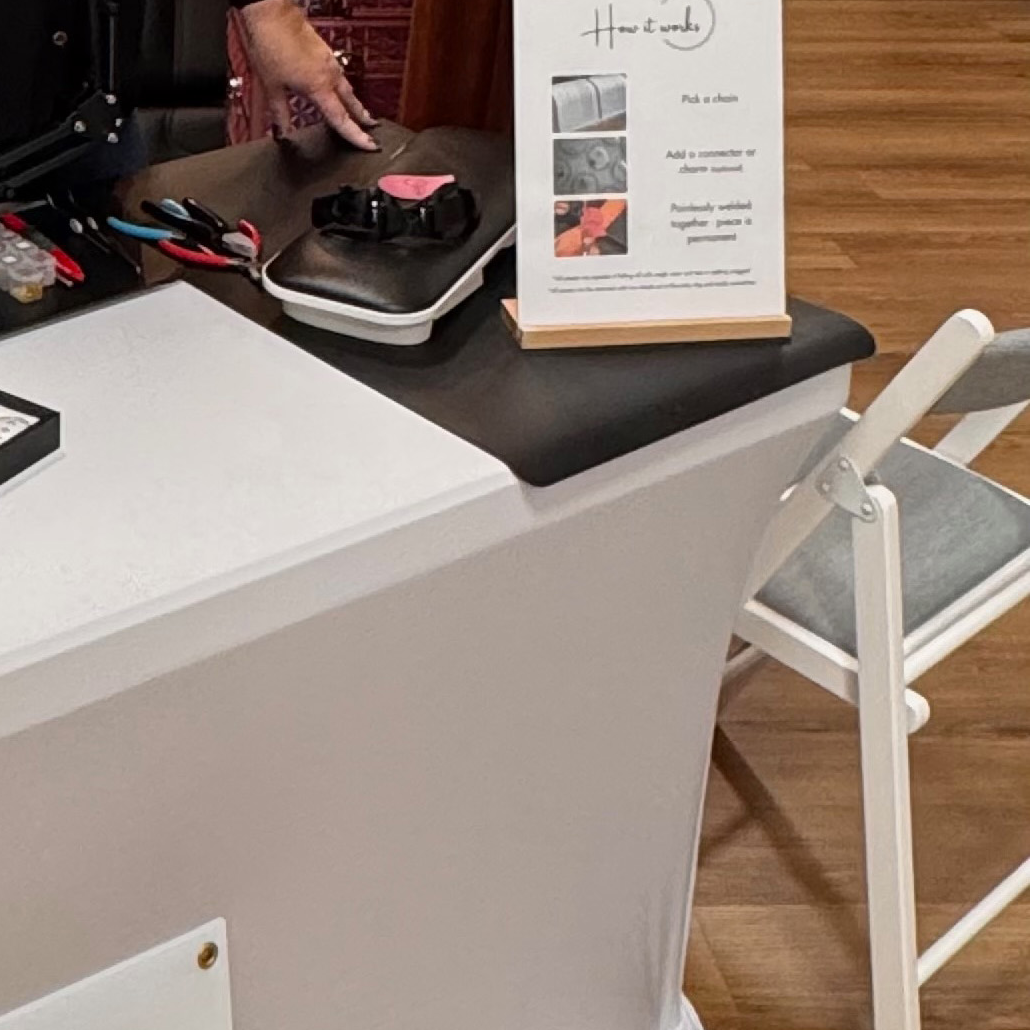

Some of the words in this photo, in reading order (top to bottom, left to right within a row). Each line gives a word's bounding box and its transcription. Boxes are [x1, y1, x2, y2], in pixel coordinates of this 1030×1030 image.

[580, 3, 640, 50] How
[643, 16, 658, 33] it
[660, 5, 701, 33] works
[681, 93, 701, 104] Pick
[712, 92, 739, 104] chain
[665, 149, 687, 160] Add
